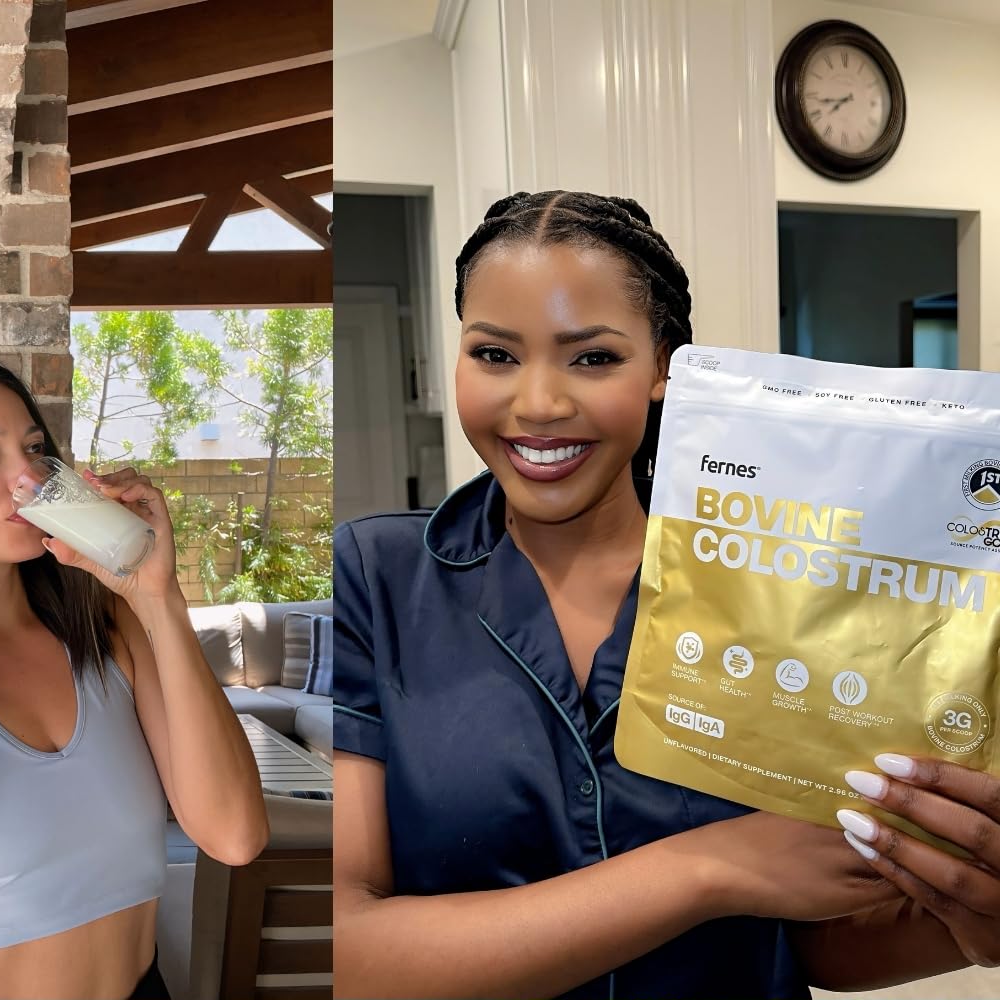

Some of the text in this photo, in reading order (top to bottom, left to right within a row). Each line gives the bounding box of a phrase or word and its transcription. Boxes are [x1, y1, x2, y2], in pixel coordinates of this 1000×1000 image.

[762, 384, 779, 393] GMO
[783, 388, 802, 396] FREE
[868, 396, 902, 406] GLUTEN
[942, 402, 965, 410] KETO
[696, 486, 863, 546] BOVINE
[693, 528, 987, 613] COLOSTRUM
[672, 663, 700, 676] IMMUNE
[721, 677, 736, 687] GUT
[668, 693, 696, 708] SOURCE
[772, 692, 805, 706] MUSCLE
[669, 707, 721, 734] IgG IgA
[830, 706, 894, 725] POST WORKOUT
[942, 709, 972, 729] 3G
[945, 733, 986, 753] COLOSTRUM
[664, 737, 708, 757] UNFLAVORED
[712, 753, 742, 768] DIETARY
[743, 762, 792, 783] SUPPLEMENT
[798, 778, 813, 788] NET
[815, 782, 827, 792] WT
[848, 790, 860, 800] OZ
